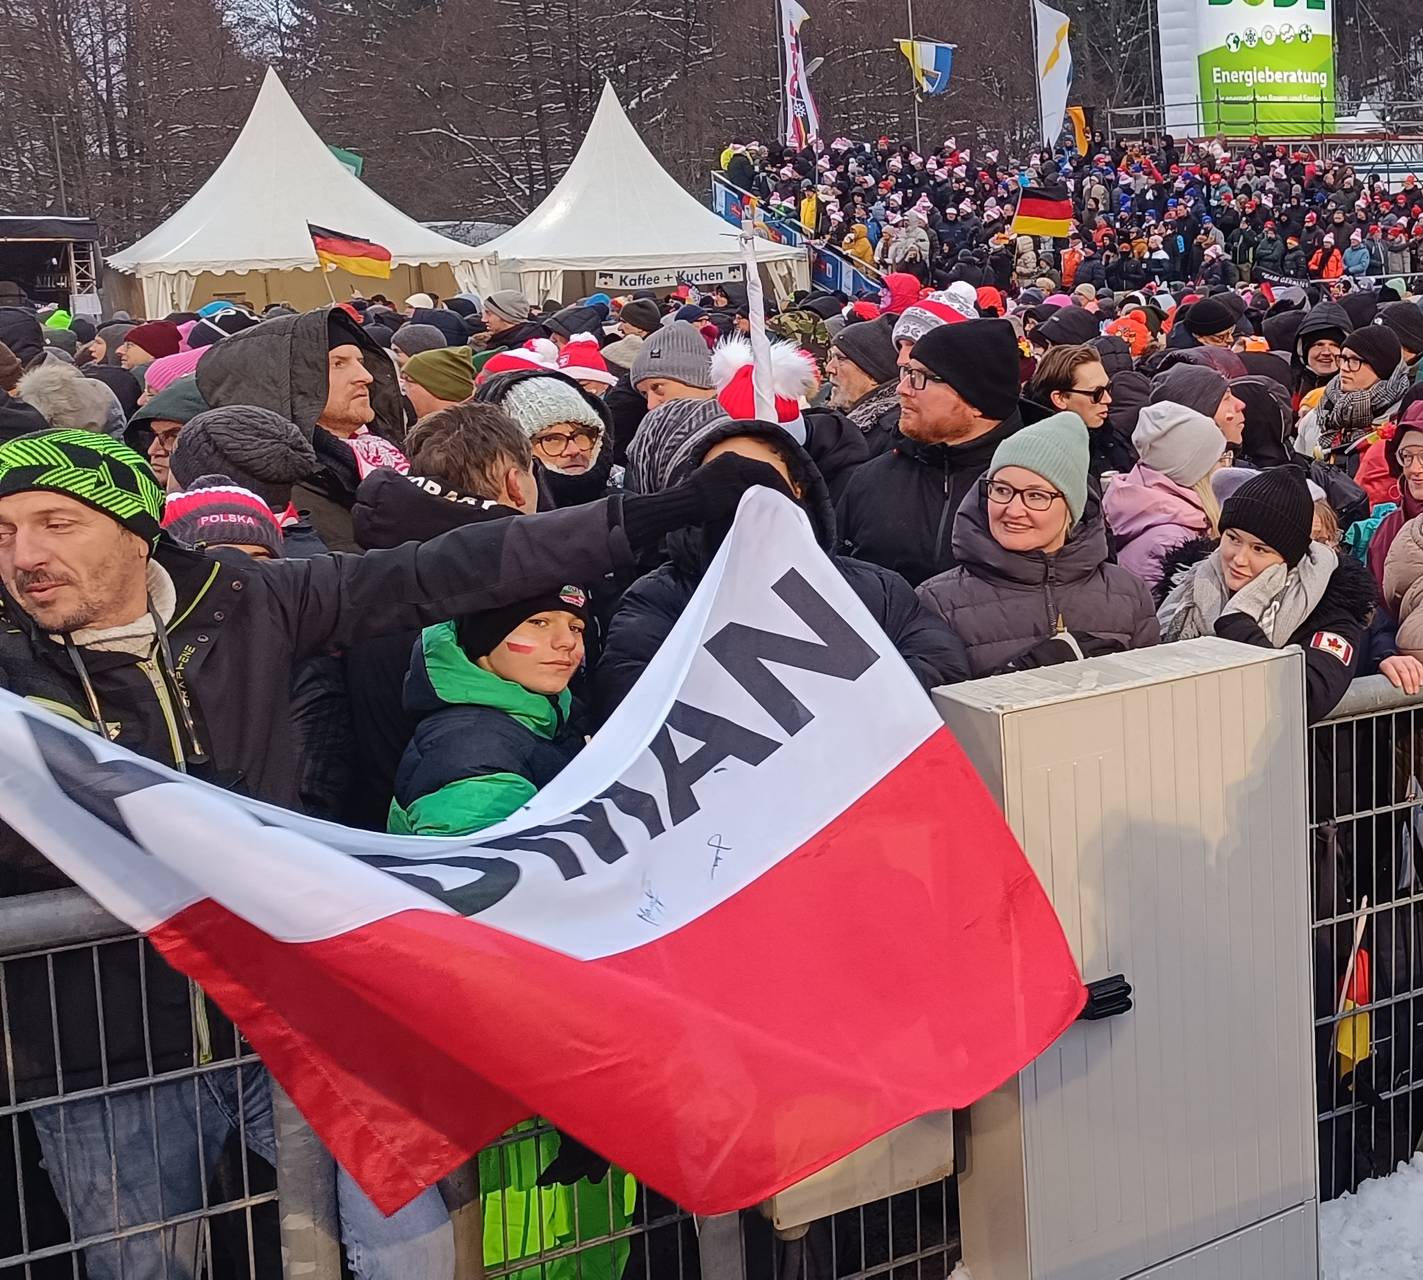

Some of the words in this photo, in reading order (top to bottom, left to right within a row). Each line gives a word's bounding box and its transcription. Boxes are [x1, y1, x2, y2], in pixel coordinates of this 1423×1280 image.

[1212, 67, 1328, 87] Energieberatung
[619, 273, 660, 287] Kaffee
[664, 273, 673, 282] +
[677, 269, 724, 284] Kuchen
[200, 513, 255, 526] POLSKA
